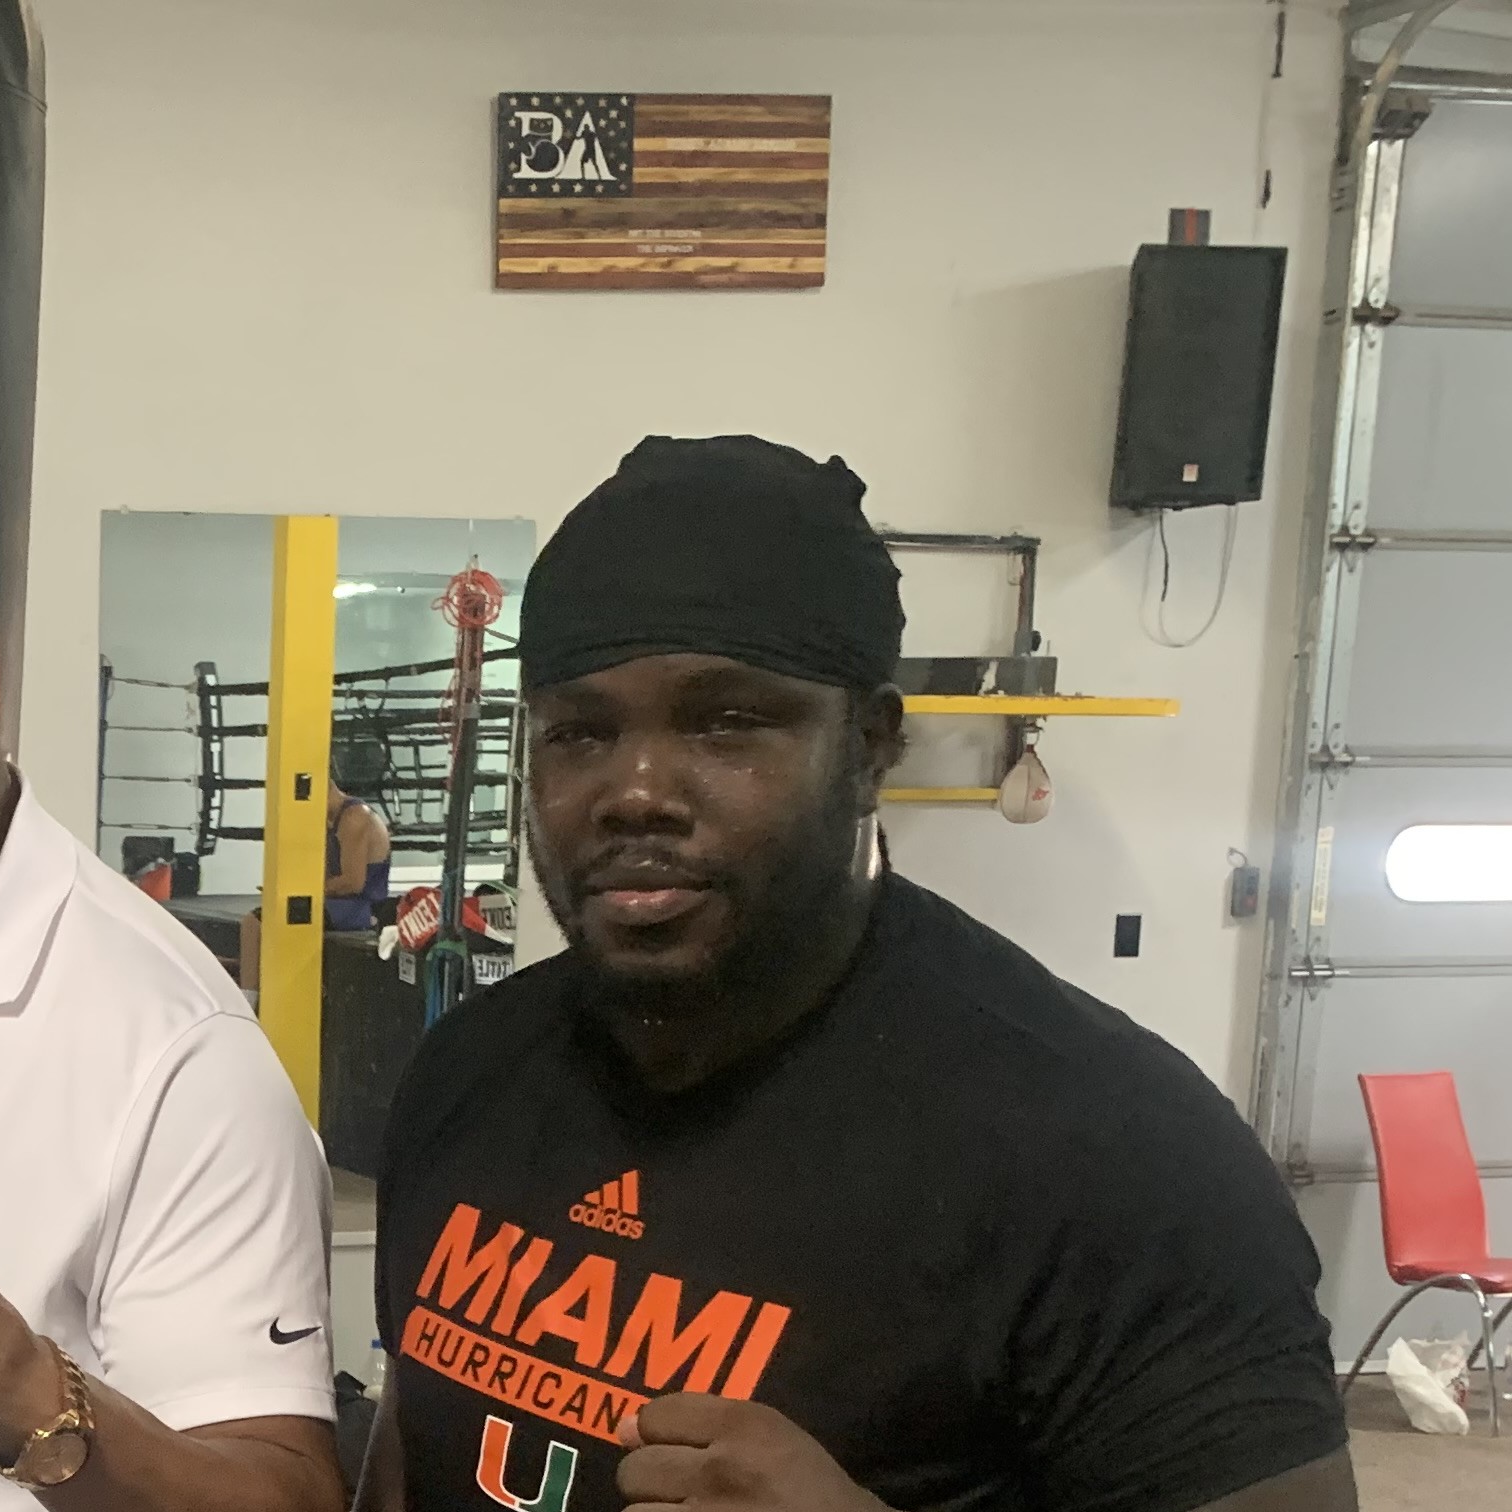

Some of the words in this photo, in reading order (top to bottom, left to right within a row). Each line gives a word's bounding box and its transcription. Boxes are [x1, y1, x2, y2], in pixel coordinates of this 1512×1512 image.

[569, 1203, 646, 1240] adidas
[416, 1202, 792, 1401] MIAMI
[414, 1316, 644, 1435] HURRICAN
